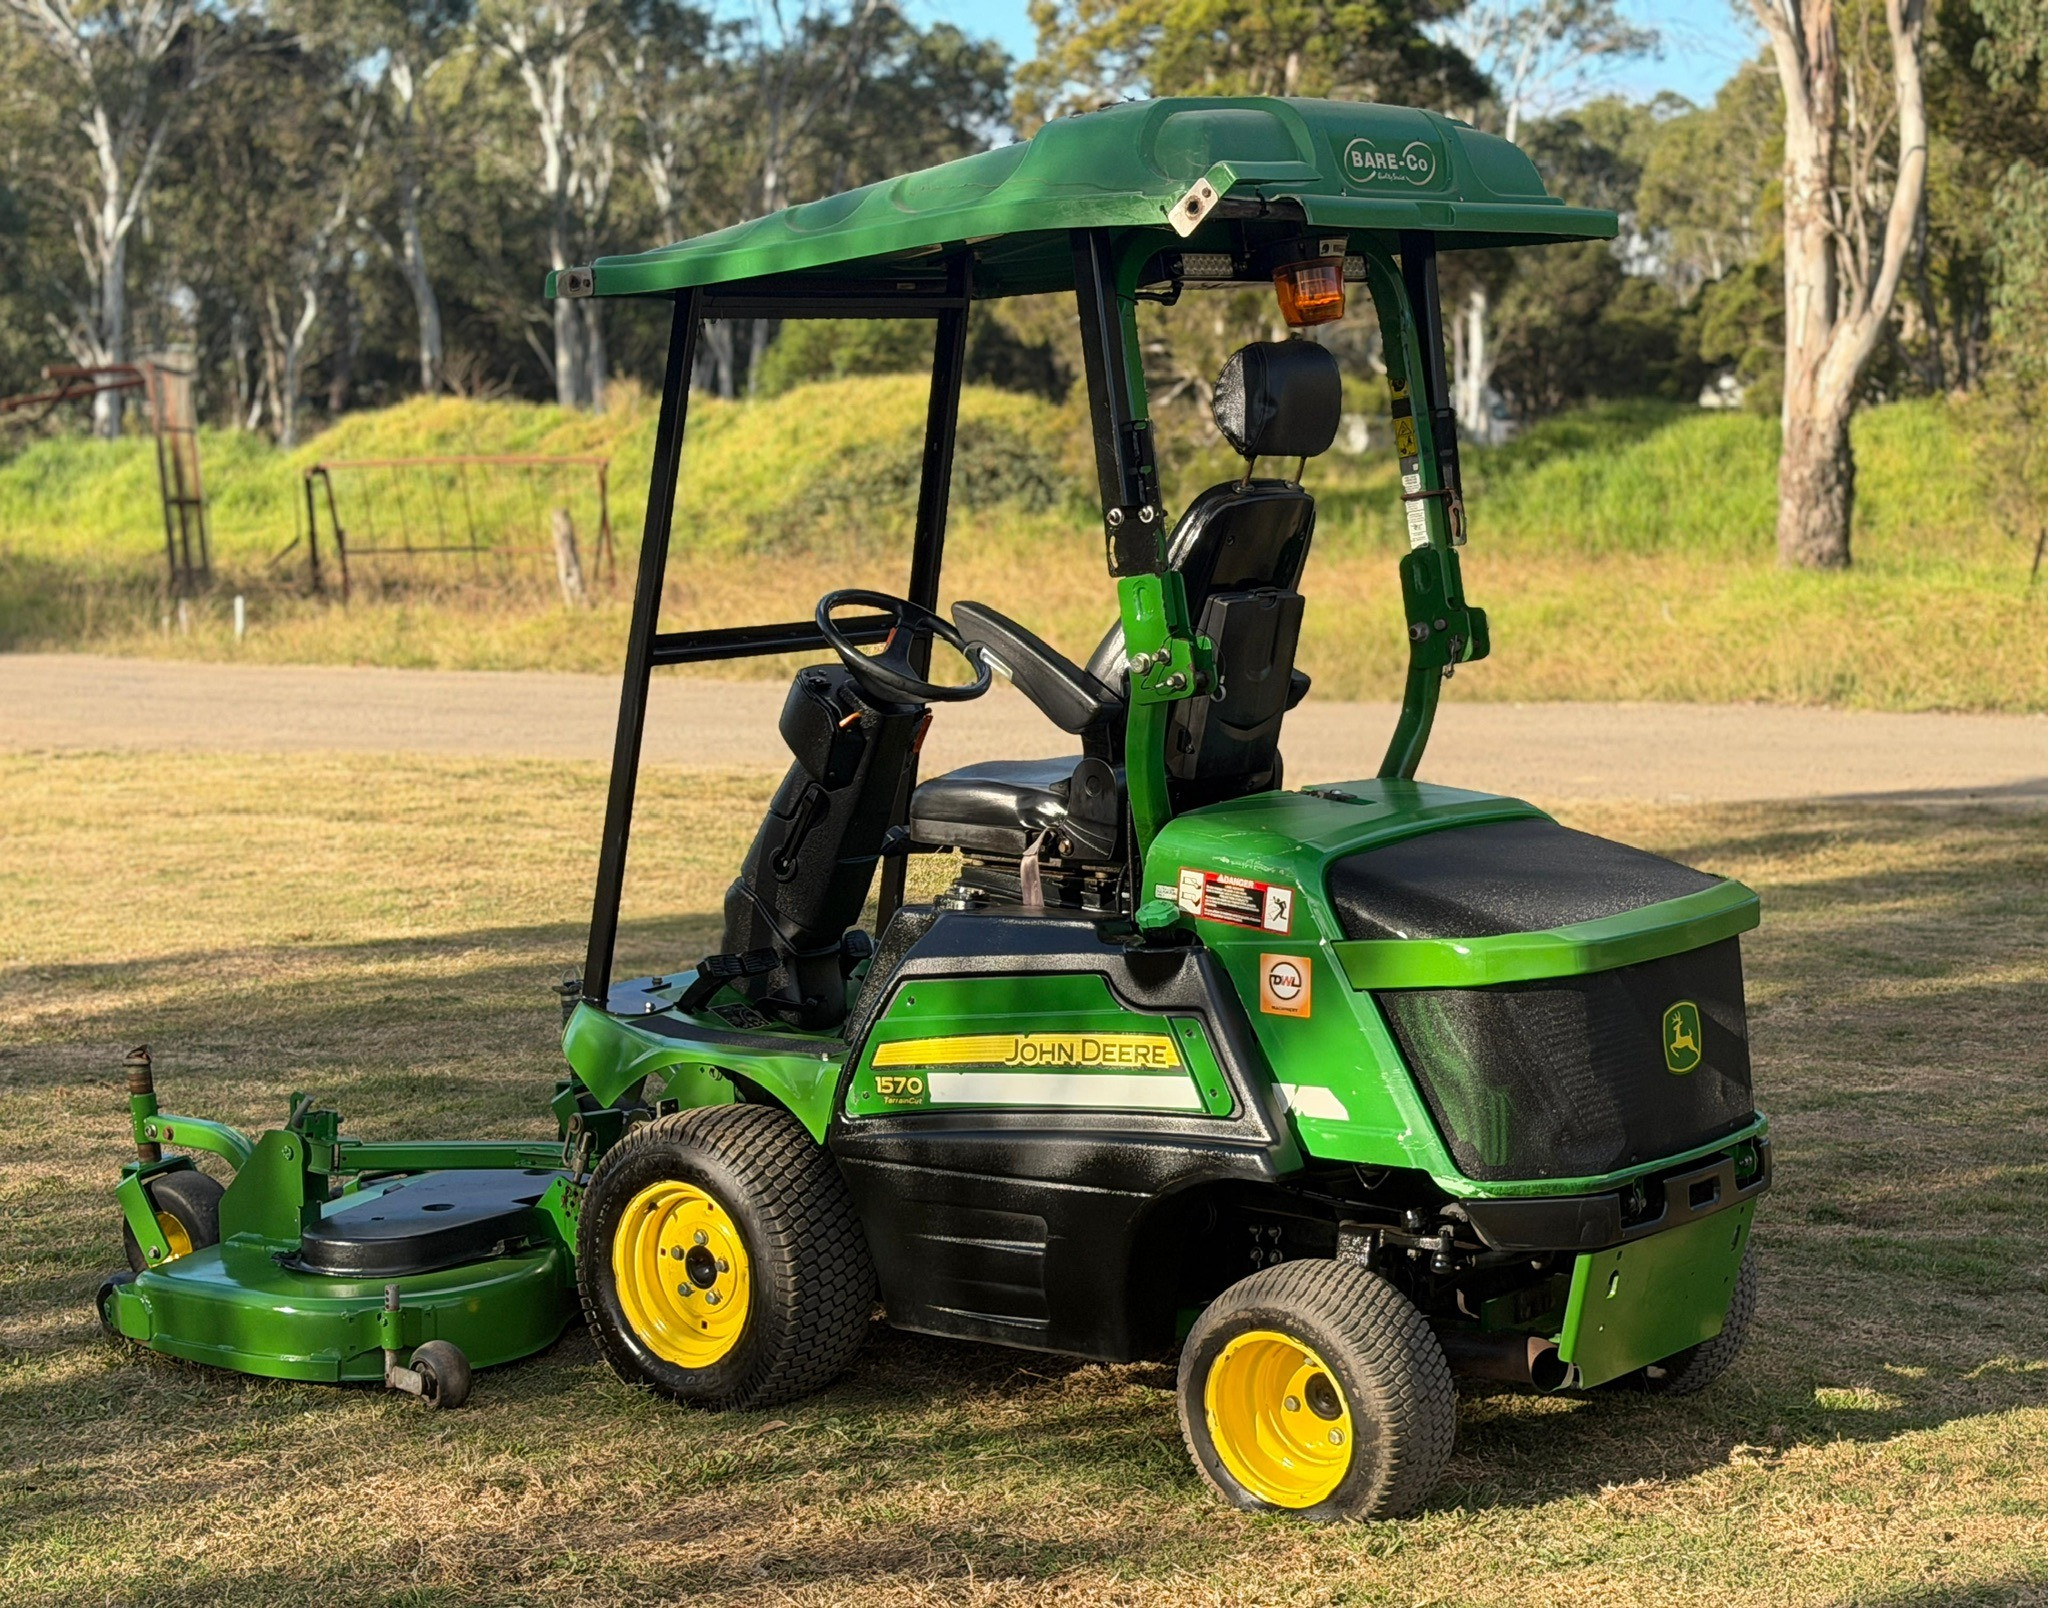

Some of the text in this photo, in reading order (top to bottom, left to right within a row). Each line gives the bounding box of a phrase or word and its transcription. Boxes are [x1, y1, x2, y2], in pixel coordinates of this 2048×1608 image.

[1351, 150, 1428, 172] BARE-Co
[1005, 1038, 1168, 1065] JOHN DEERE
[875, 1075, 923, 1095] 1570
[884, 1095, 923, 1105] TerrainCut
